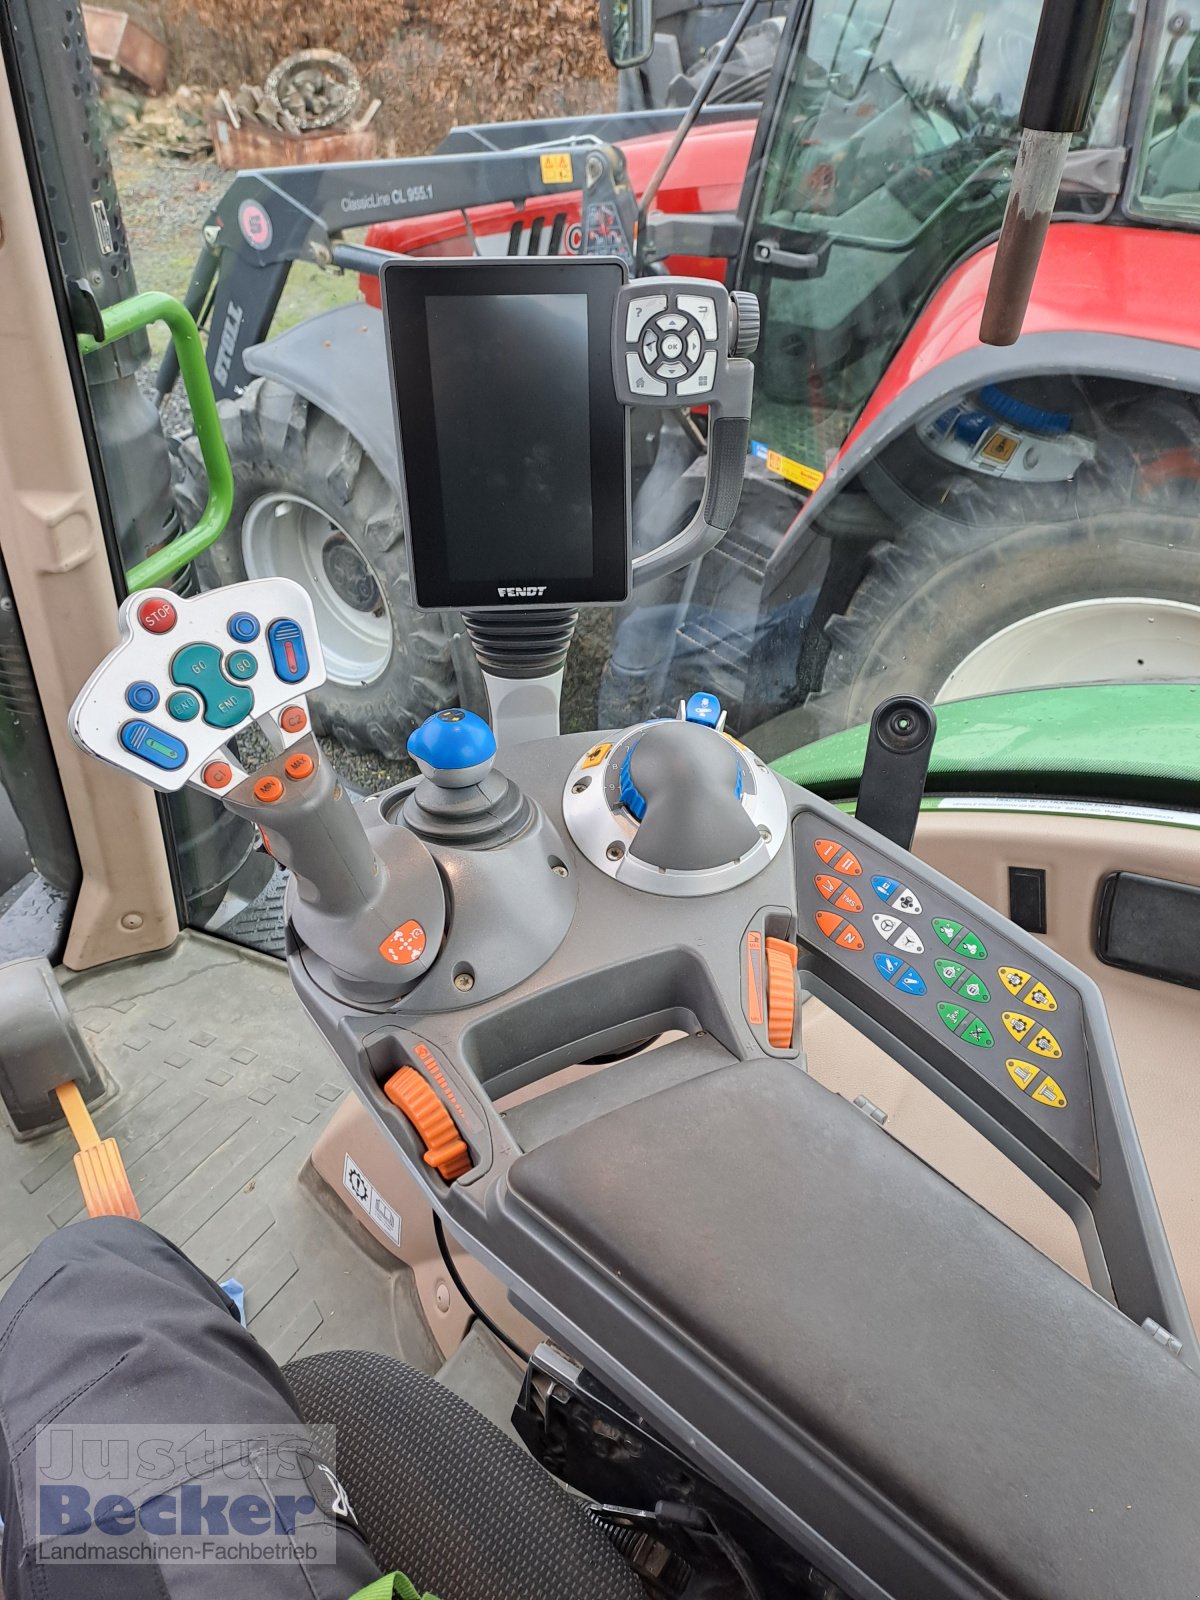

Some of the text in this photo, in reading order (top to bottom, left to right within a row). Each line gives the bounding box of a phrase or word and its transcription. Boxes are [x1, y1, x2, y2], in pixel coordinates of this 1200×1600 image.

[391, 188, 407, 205] CL
[407, 184, 434, 203] 955.1
[213, 300, 243, 388] STOLL
[667, 343, 678, 351] OK
[497, 585, 548, 598] FENDT
[145, 604, 171, 627] STOP
[191, 660, 207, 674] GO
[236, 658, 251, 672] GO
[174, 697, 196, 715] END
[218, 695, 239, 713] END
[259, 780, 277, 794] MIN
[609, 783, 616, 791] 9
[842, 894, 856, 907] TMS
[843, 932, 856, 944] N
